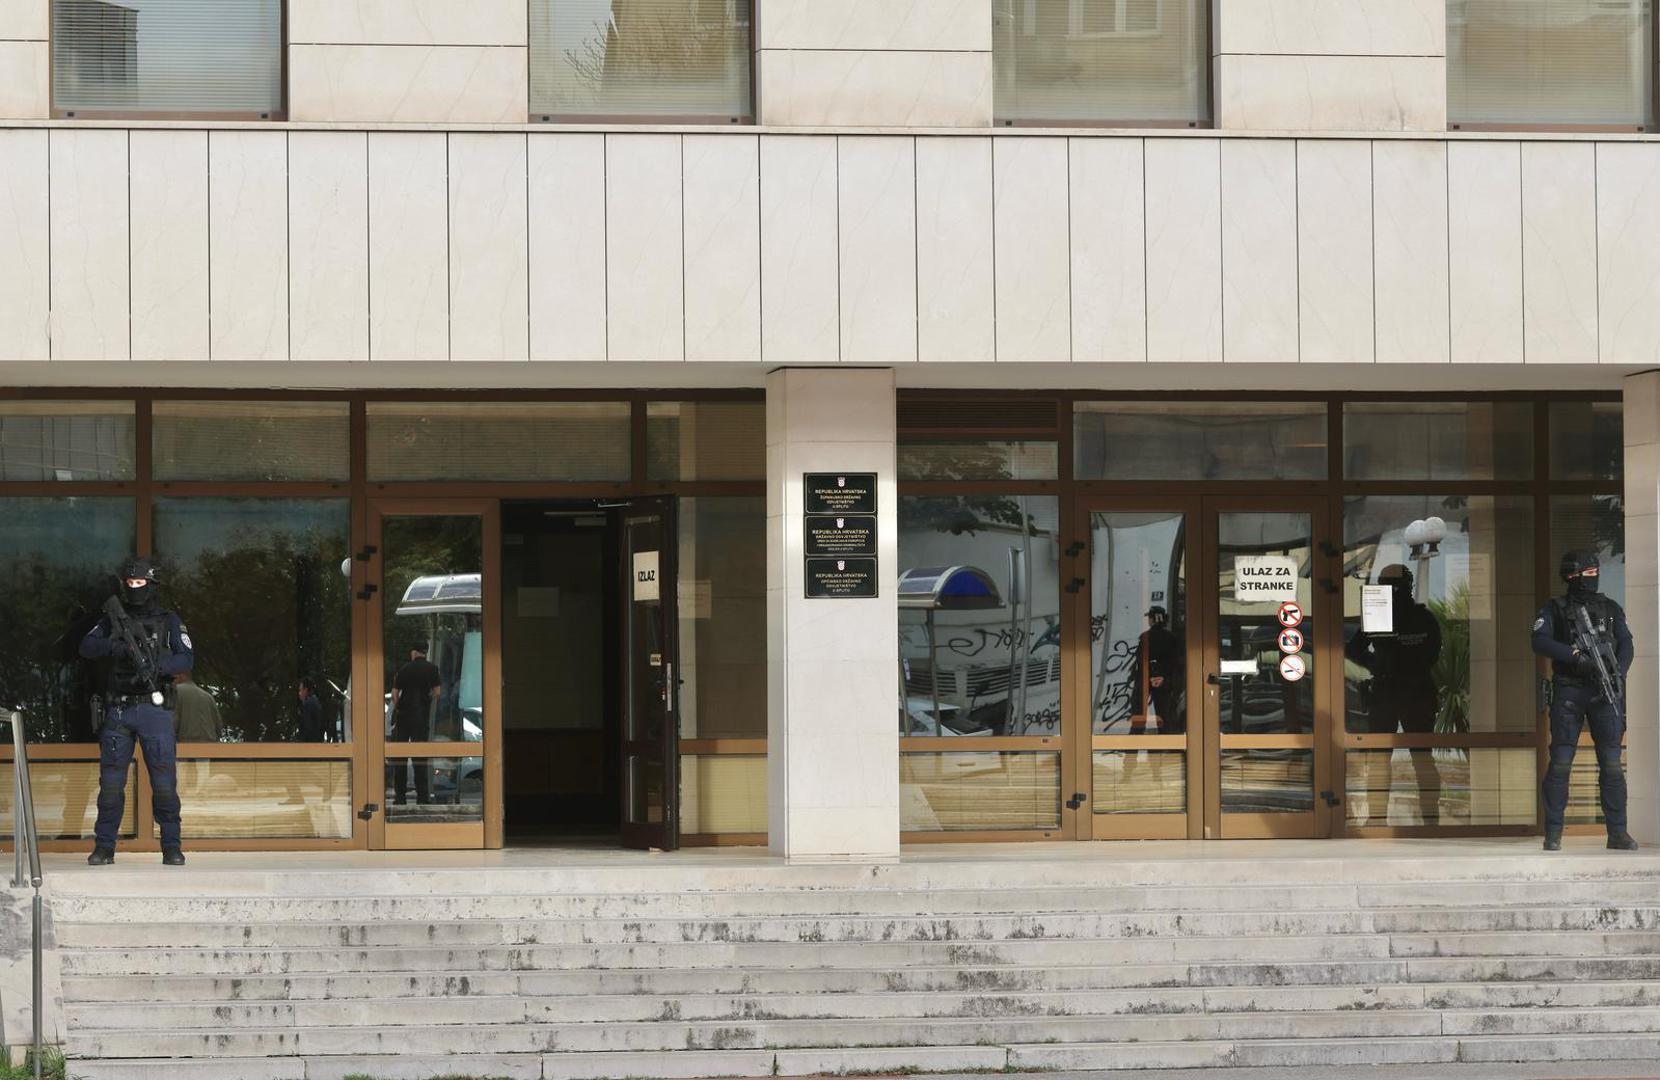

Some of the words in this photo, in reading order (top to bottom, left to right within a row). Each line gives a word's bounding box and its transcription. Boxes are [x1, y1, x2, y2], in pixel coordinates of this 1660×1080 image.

[637, 570, 655, 582] IZLAZ
[1242, 567, 1272, 576] ULAZ
[1275, 567, 1290, 576] ZA
[1240, 582, 1294, 591] STRANKE
